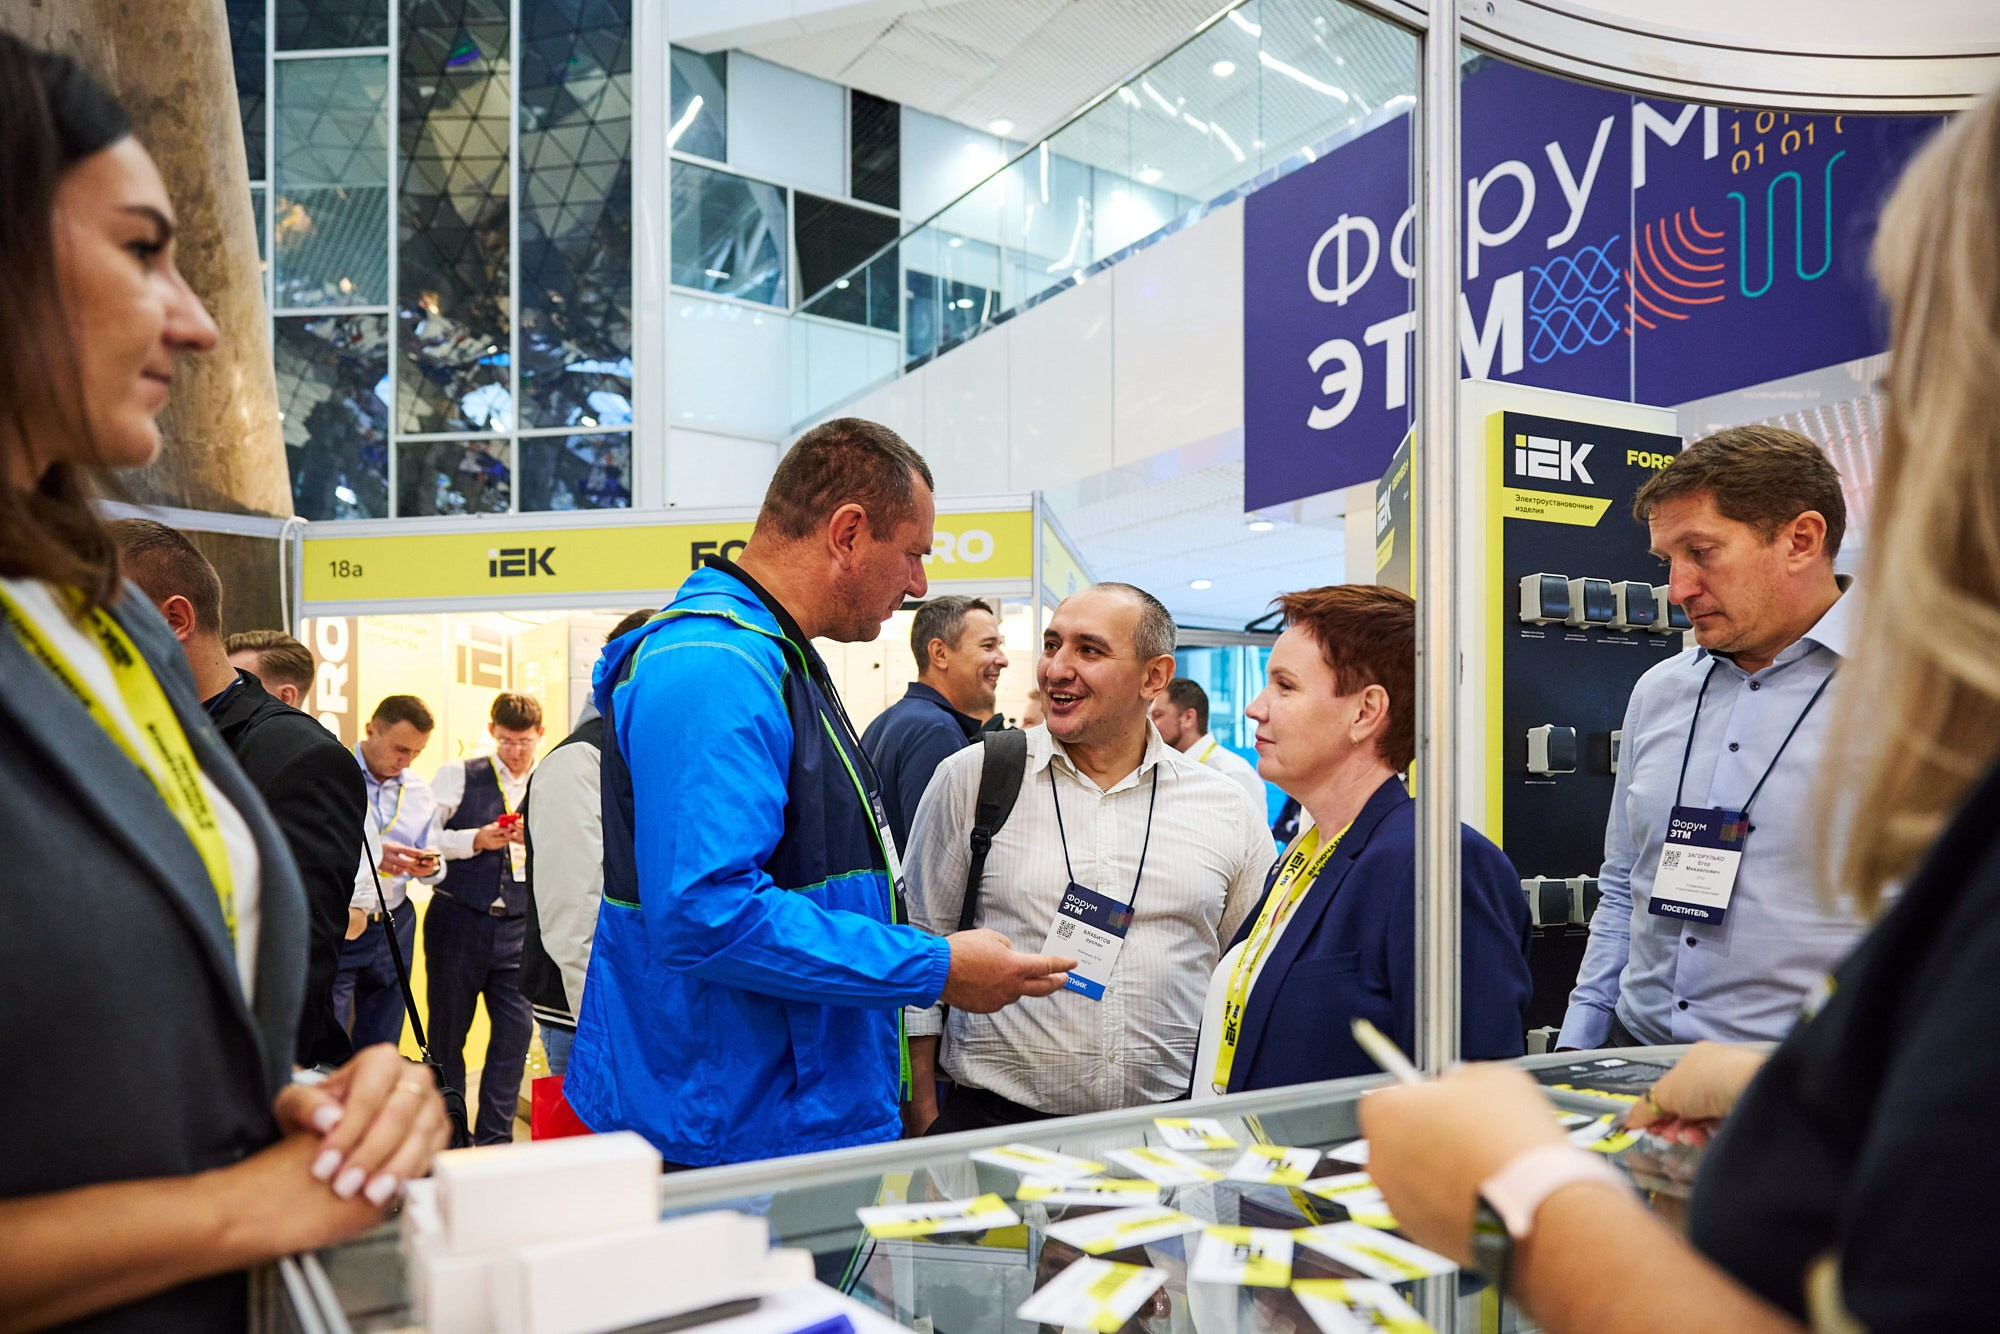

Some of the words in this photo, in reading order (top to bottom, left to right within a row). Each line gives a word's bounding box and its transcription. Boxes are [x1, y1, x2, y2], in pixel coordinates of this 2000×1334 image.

[1307, 270, 1524, 430] ЭТМ
[1626, 449, 1677, 470] FORS
[1515, 493, 1594, 512] Электроустановочные
[1515, 505, 1545, 515] изделия
[691, 539, 748, 571] FO
[922, 529, 994, 564] RO
[1671, 818, 1707, 831] Форум
[1669, 828, 1691, 840] ЭТМ
[1063, 901, 1084, 916] ЭТМ
[1066, 893, 1098, 913] Форум
[1660, 903, 1709, 918] ПОСЕТИТЕЛЬ
[1067, 976, 1088, 990] ТНИК
